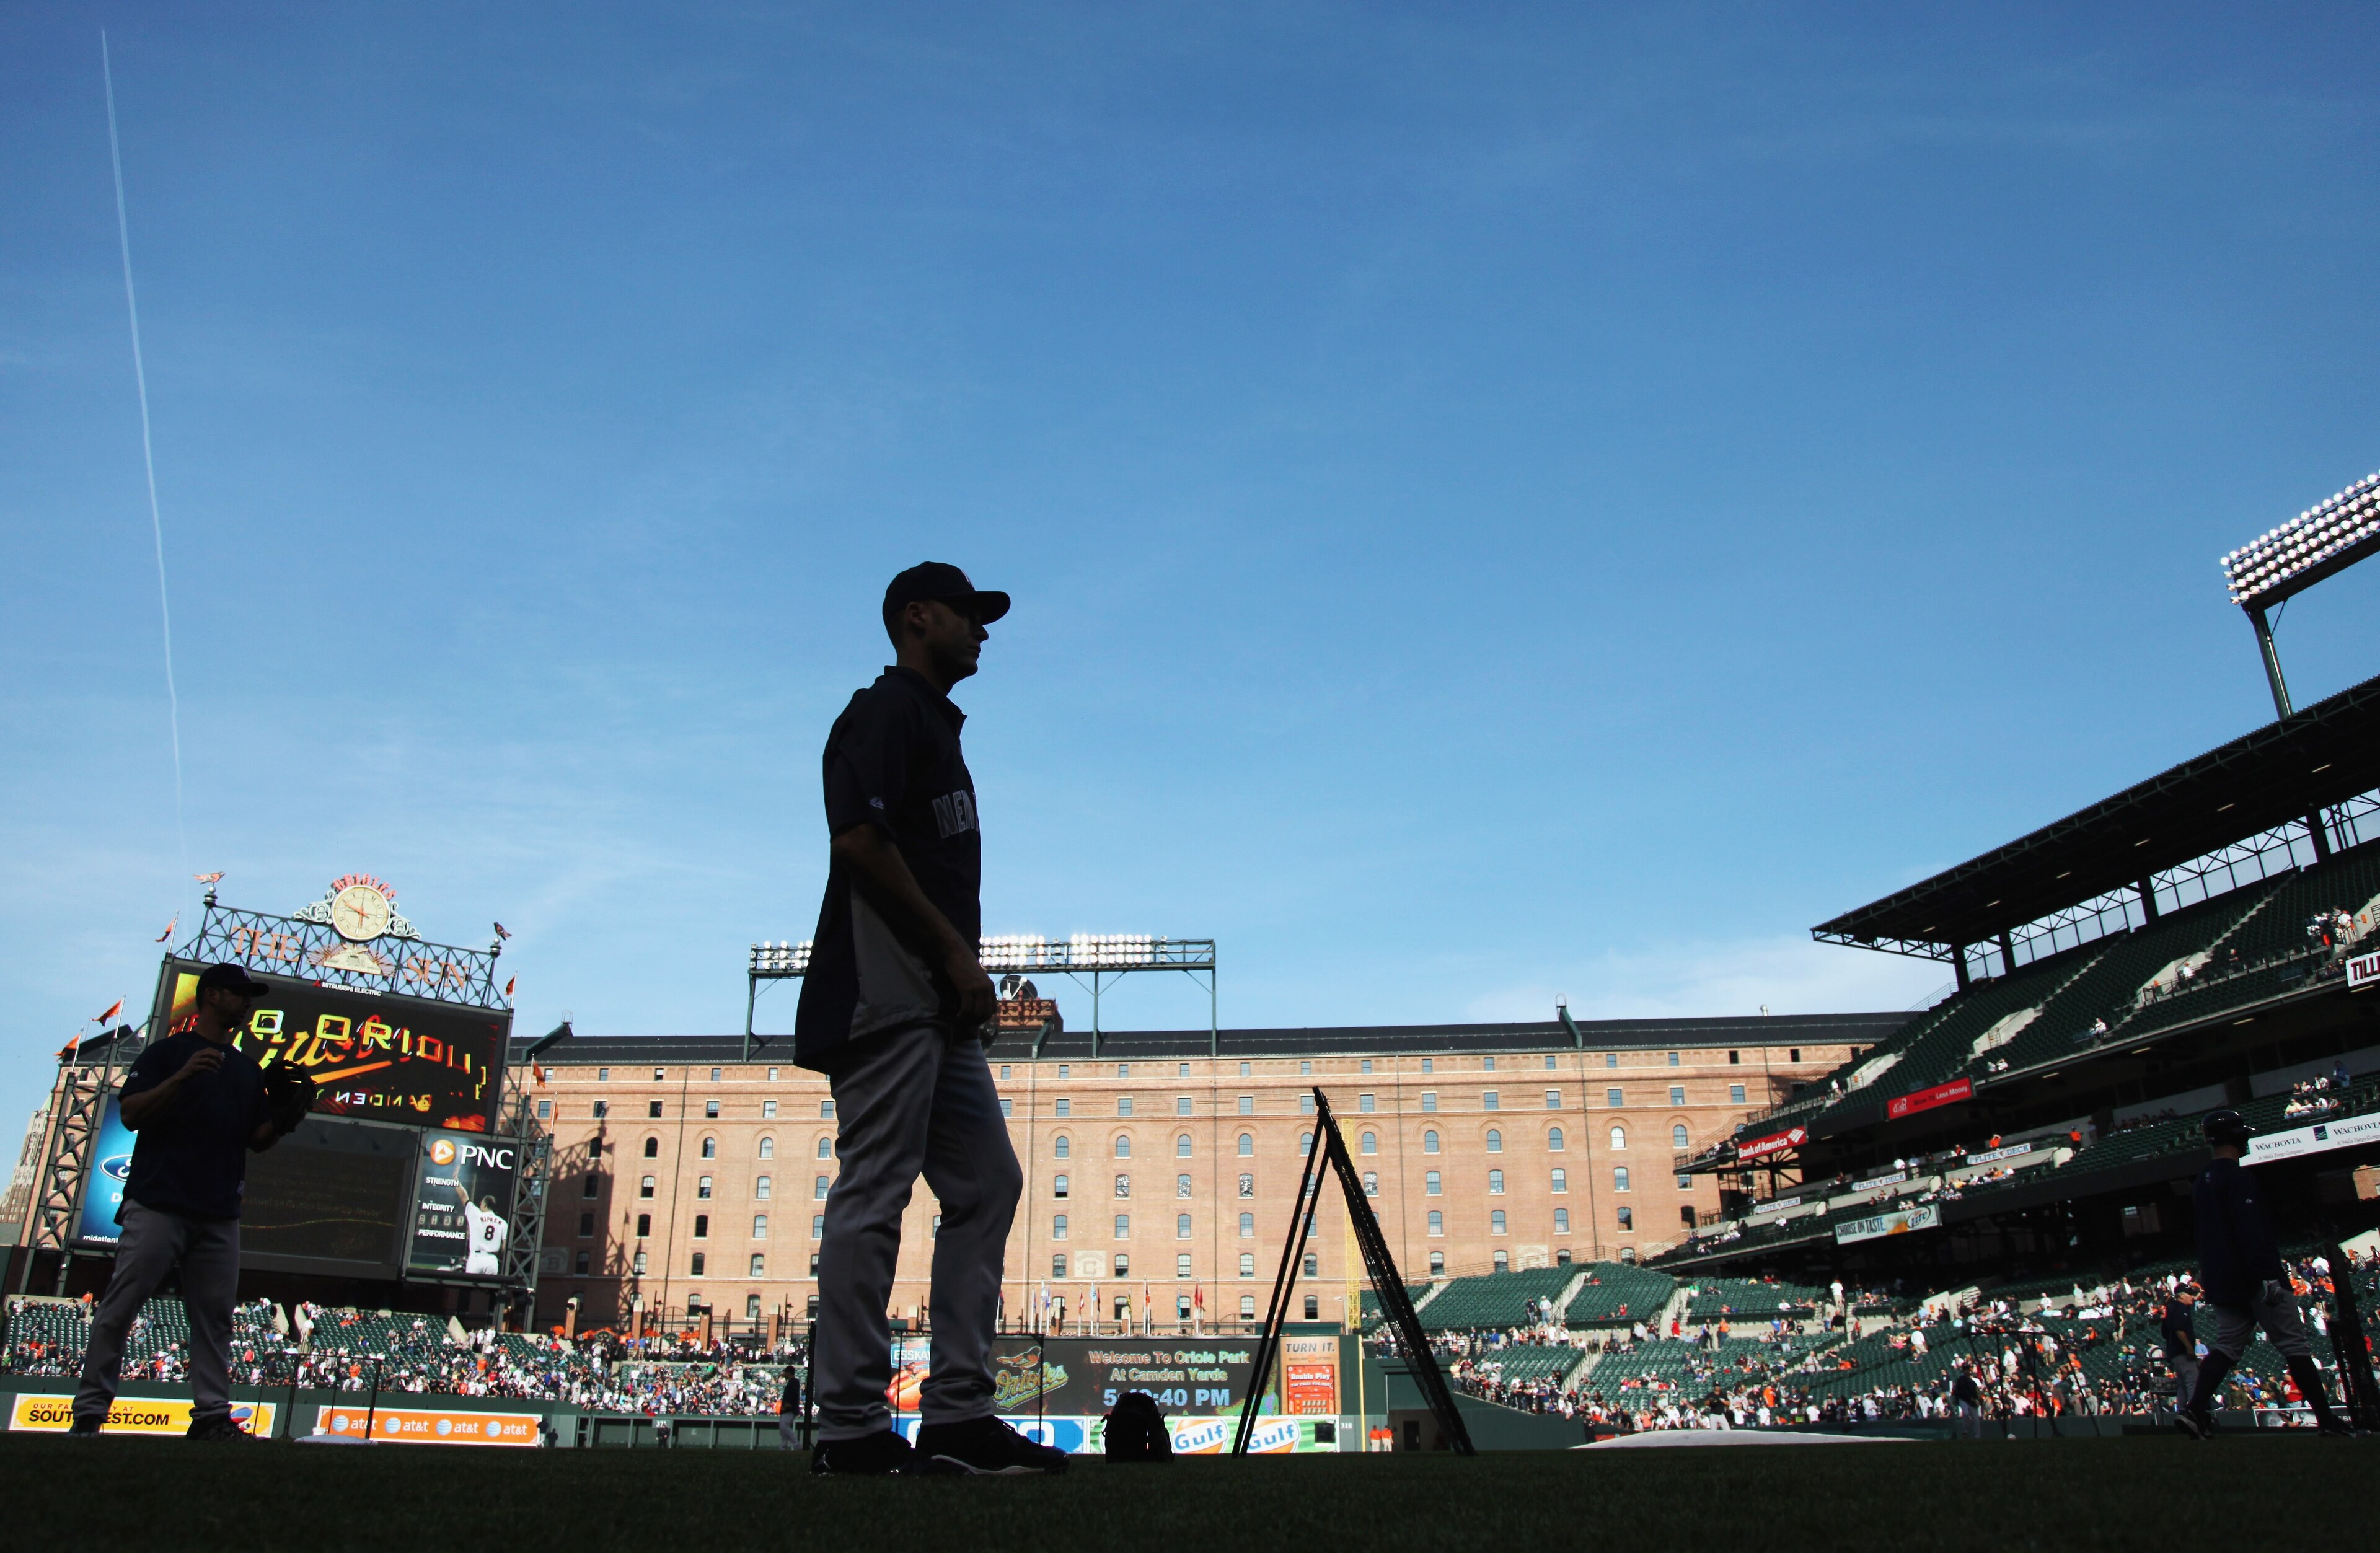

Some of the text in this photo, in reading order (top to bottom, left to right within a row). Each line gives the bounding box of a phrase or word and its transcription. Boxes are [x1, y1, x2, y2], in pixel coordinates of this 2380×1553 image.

[232, 926, 469, 990] THE SUN
[322, 982, 382, 996] MITSUBISHI ELECTRIC
[2333, 1120, 2380, 1135] WACHOVIA
[1738, 1137, 1787, 1158] Bank of America
[2255, 1137, 2301, 1151] WACHOVIA
[461, 1145, 513, 1169] PNC
[1975, 1145, 2029, 1163] FLITE DECK
[426, 1177, 459, 1187] STRENGTH
[422, 1202, 454, 1212] INTEGRITY
[480, 1216, 502, 1225] RIPKEN
[418, 1229, 466, 1240] PERFORMANCE
[484, 1225, 495, 1241] 8
[1836, 1223, 1858, 1237] CHOOSE
[1858, 1220, 1866, 1233] ON
[1286, 1342, 1335, 1353] TURN IT.
[1088, 1351, 1251, 1364] Welcome To Oriole Park
[1110, 1368, 1228, 1381] At Camden Yards
[1315, 1372, 1331, 1381] Play
[1195, 1389, 1230, 1406] PM
[403, 1421, 429, 1432] at&t
[454, 1422, 479, 1433] at&t
[503, 1423, 528, 1435] at&t
[1174, 1424, 1224, 1450] Gulf
[1248, 1423, 1295, 1450] Gulf
